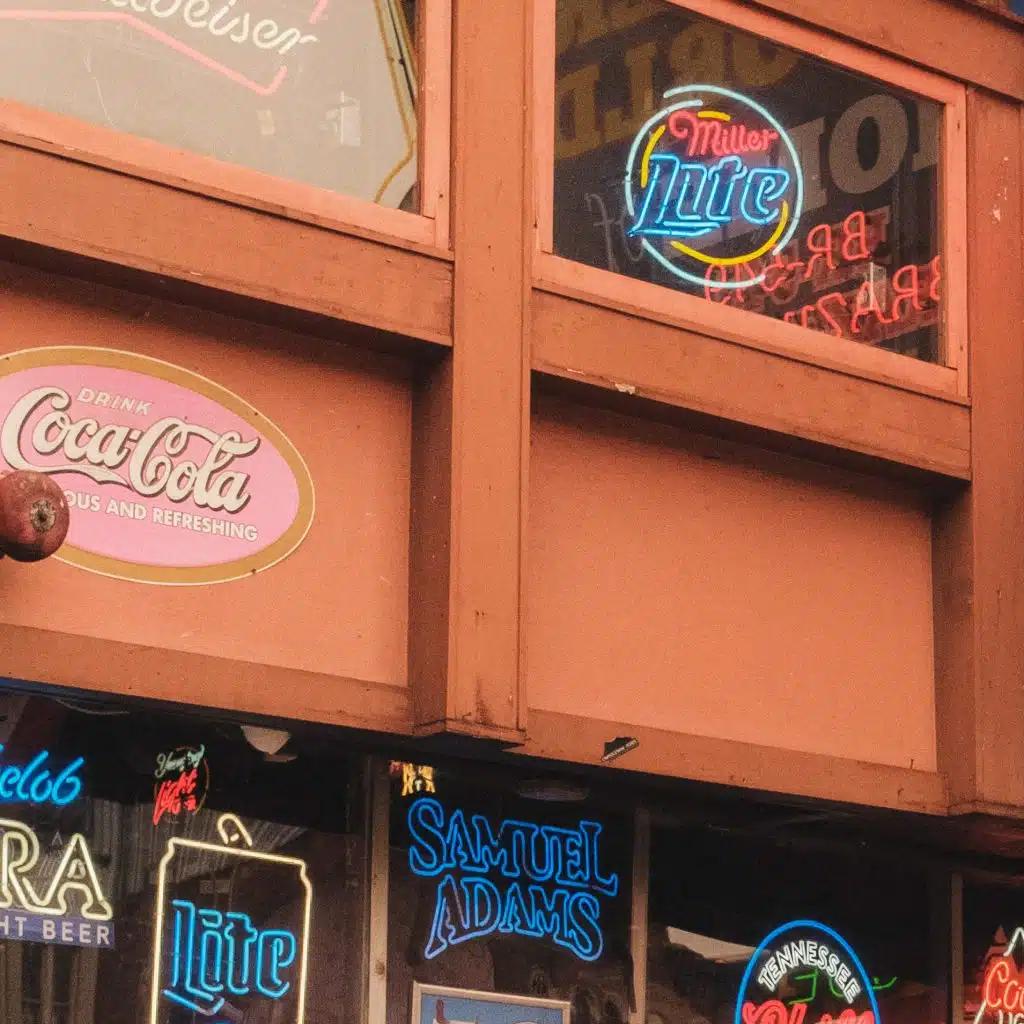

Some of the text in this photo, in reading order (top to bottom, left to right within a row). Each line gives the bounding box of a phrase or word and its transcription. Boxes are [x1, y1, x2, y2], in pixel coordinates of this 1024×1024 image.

[669, 110, 779, 157] Miller
[629, 154, 790, 238] Lite
[77, 387, 153, 416] DRINK
[0, 386, 260, 514] Coca-Cola
[106, 499, 147, 521] AND
[152, 507, 259, 542] REFRESHING
[408, 797, 620, 897] SAMUEL
[42, 919, 111, 946] BEER
[424, 874, 604, 962] ADAMS
[163, 899, 297, 1016] Lite
[757, 939, 863, 1005] TENNESSEE
